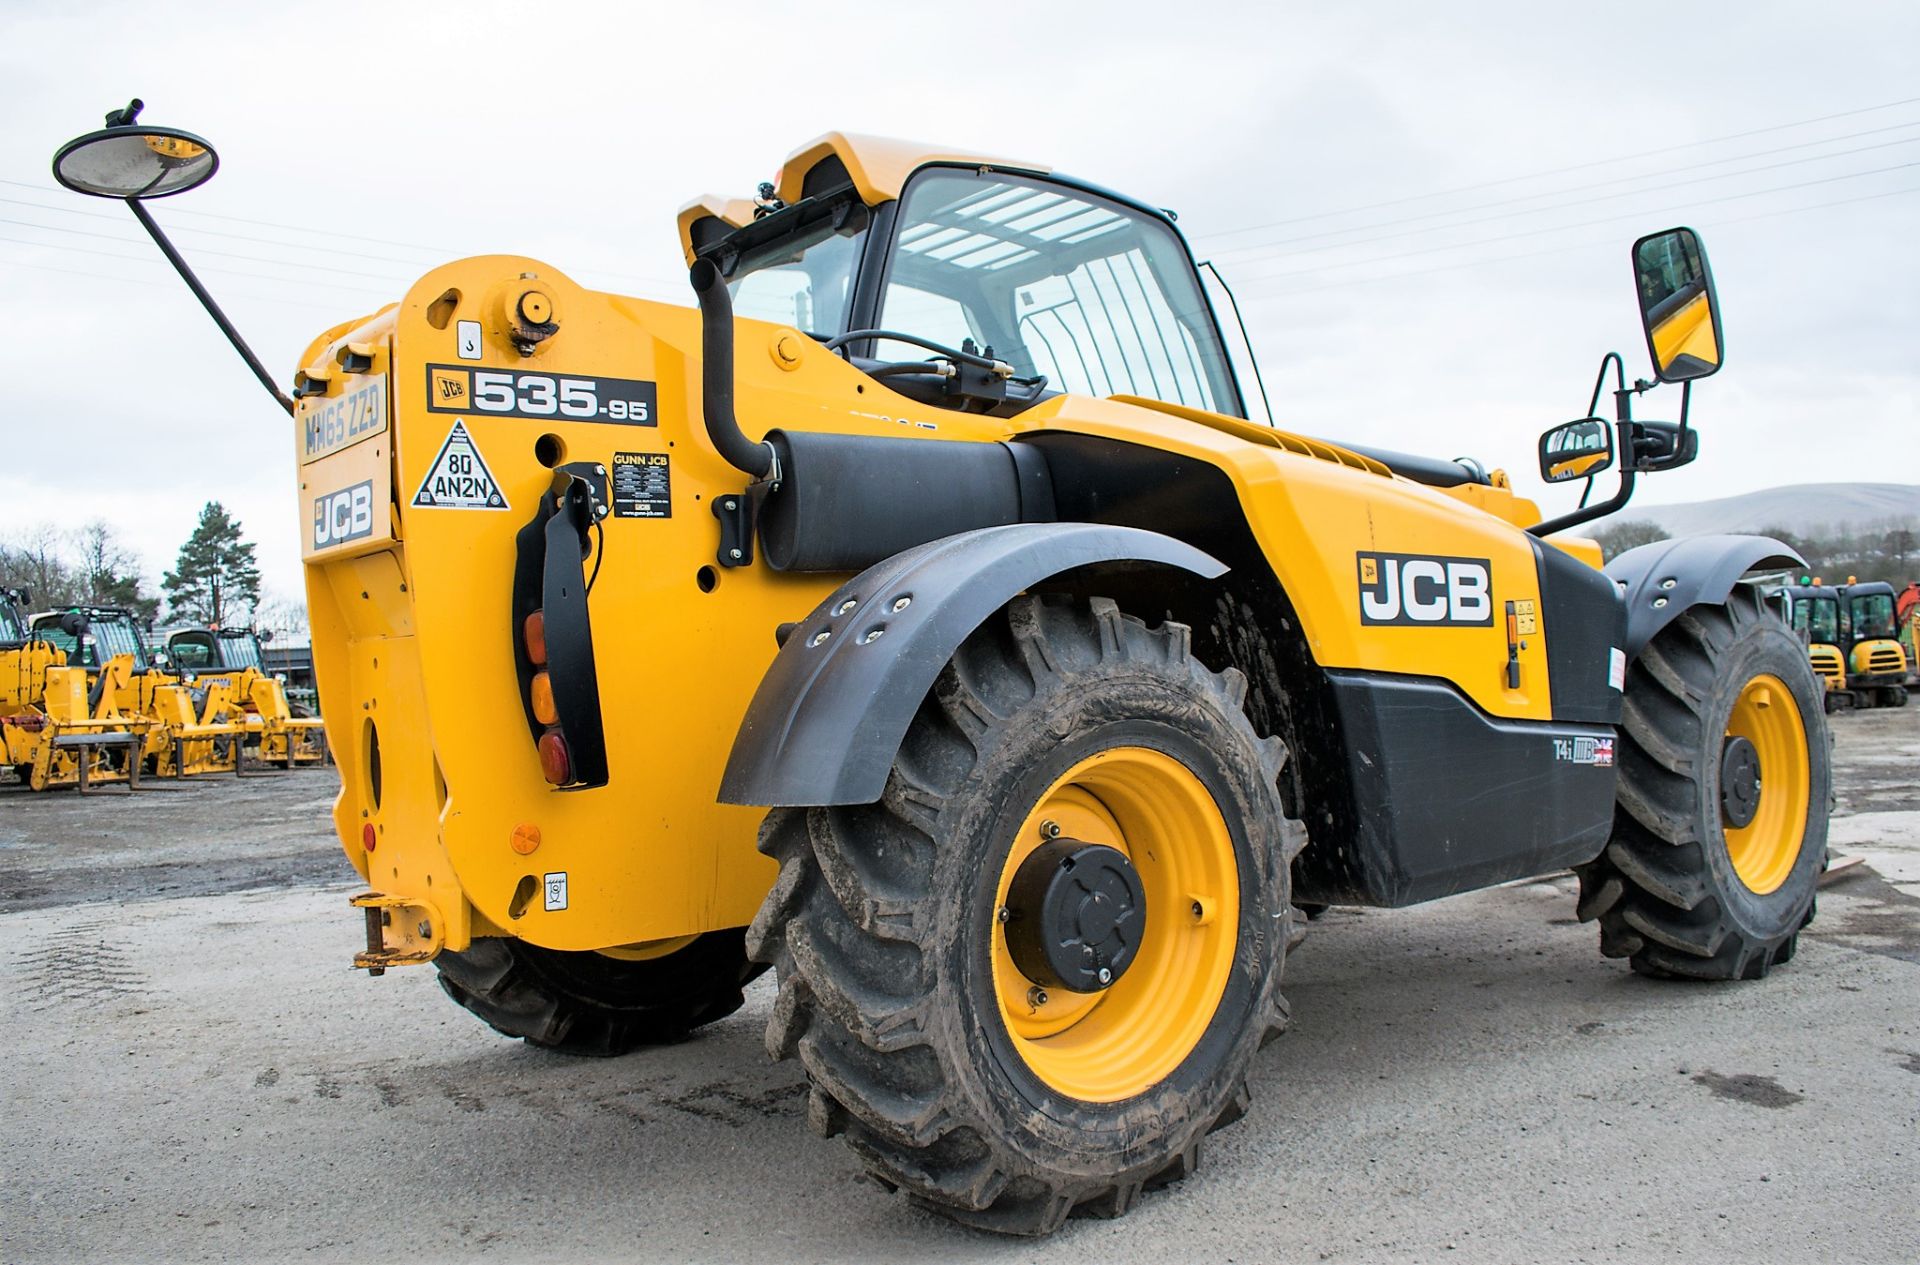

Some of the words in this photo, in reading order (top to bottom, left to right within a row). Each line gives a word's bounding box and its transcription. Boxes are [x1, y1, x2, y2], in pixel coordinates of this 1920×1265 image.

[440, 380, 464, 398] JCB
[614, 454, 646, 465] GUNN
[648, 456, 668, 466] JCB
[435, 476, 488, 499] AN2N
[315, 484, 372, 544] JCB
[1362, 559, 1492, 621] JCB
